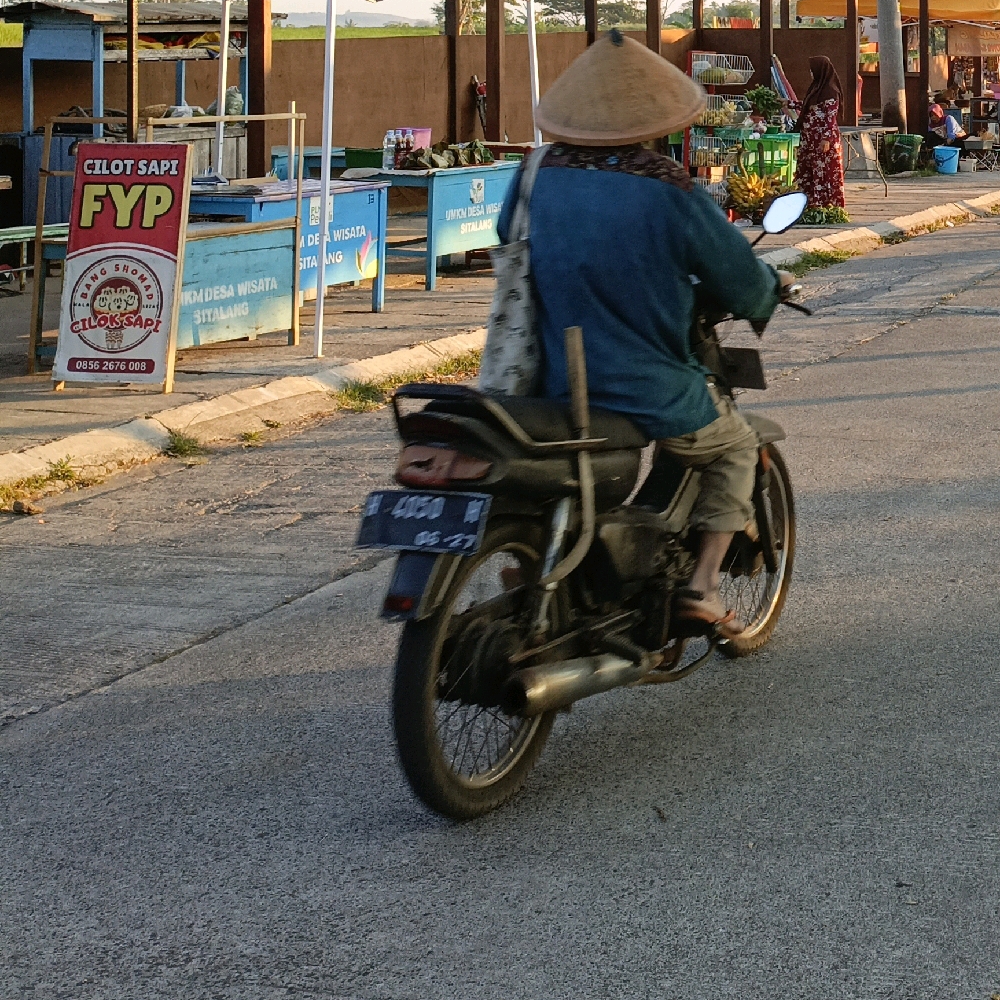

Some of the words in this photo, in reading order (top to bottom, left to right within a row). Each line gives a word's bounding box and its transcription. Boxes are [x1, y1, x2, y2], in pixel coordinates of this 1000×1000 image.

[83, 159, 135, 175] CILOT
[137, 159, 179, 175] SAPI
[79, 183, 174, 229] FYP
[468, 204, 485, 217] DESA
[333, 225, 367, 242] WISATA
[81, 268, 107, 299] BANG
[114, 264, 154, 300] SHOMAD
[204, 284, 235, 302] DESA
[237, 277, 278, 297] WISATA
[70, 313, 119, 335] CILOK
[124, 315, 162, 333] SAPI
[193, 302, 249, 325] SITALANG
[76, 360, 99, 370] 0856
[102, 361, 126, 371] 2676
[129, 362, 147, 371] 008
